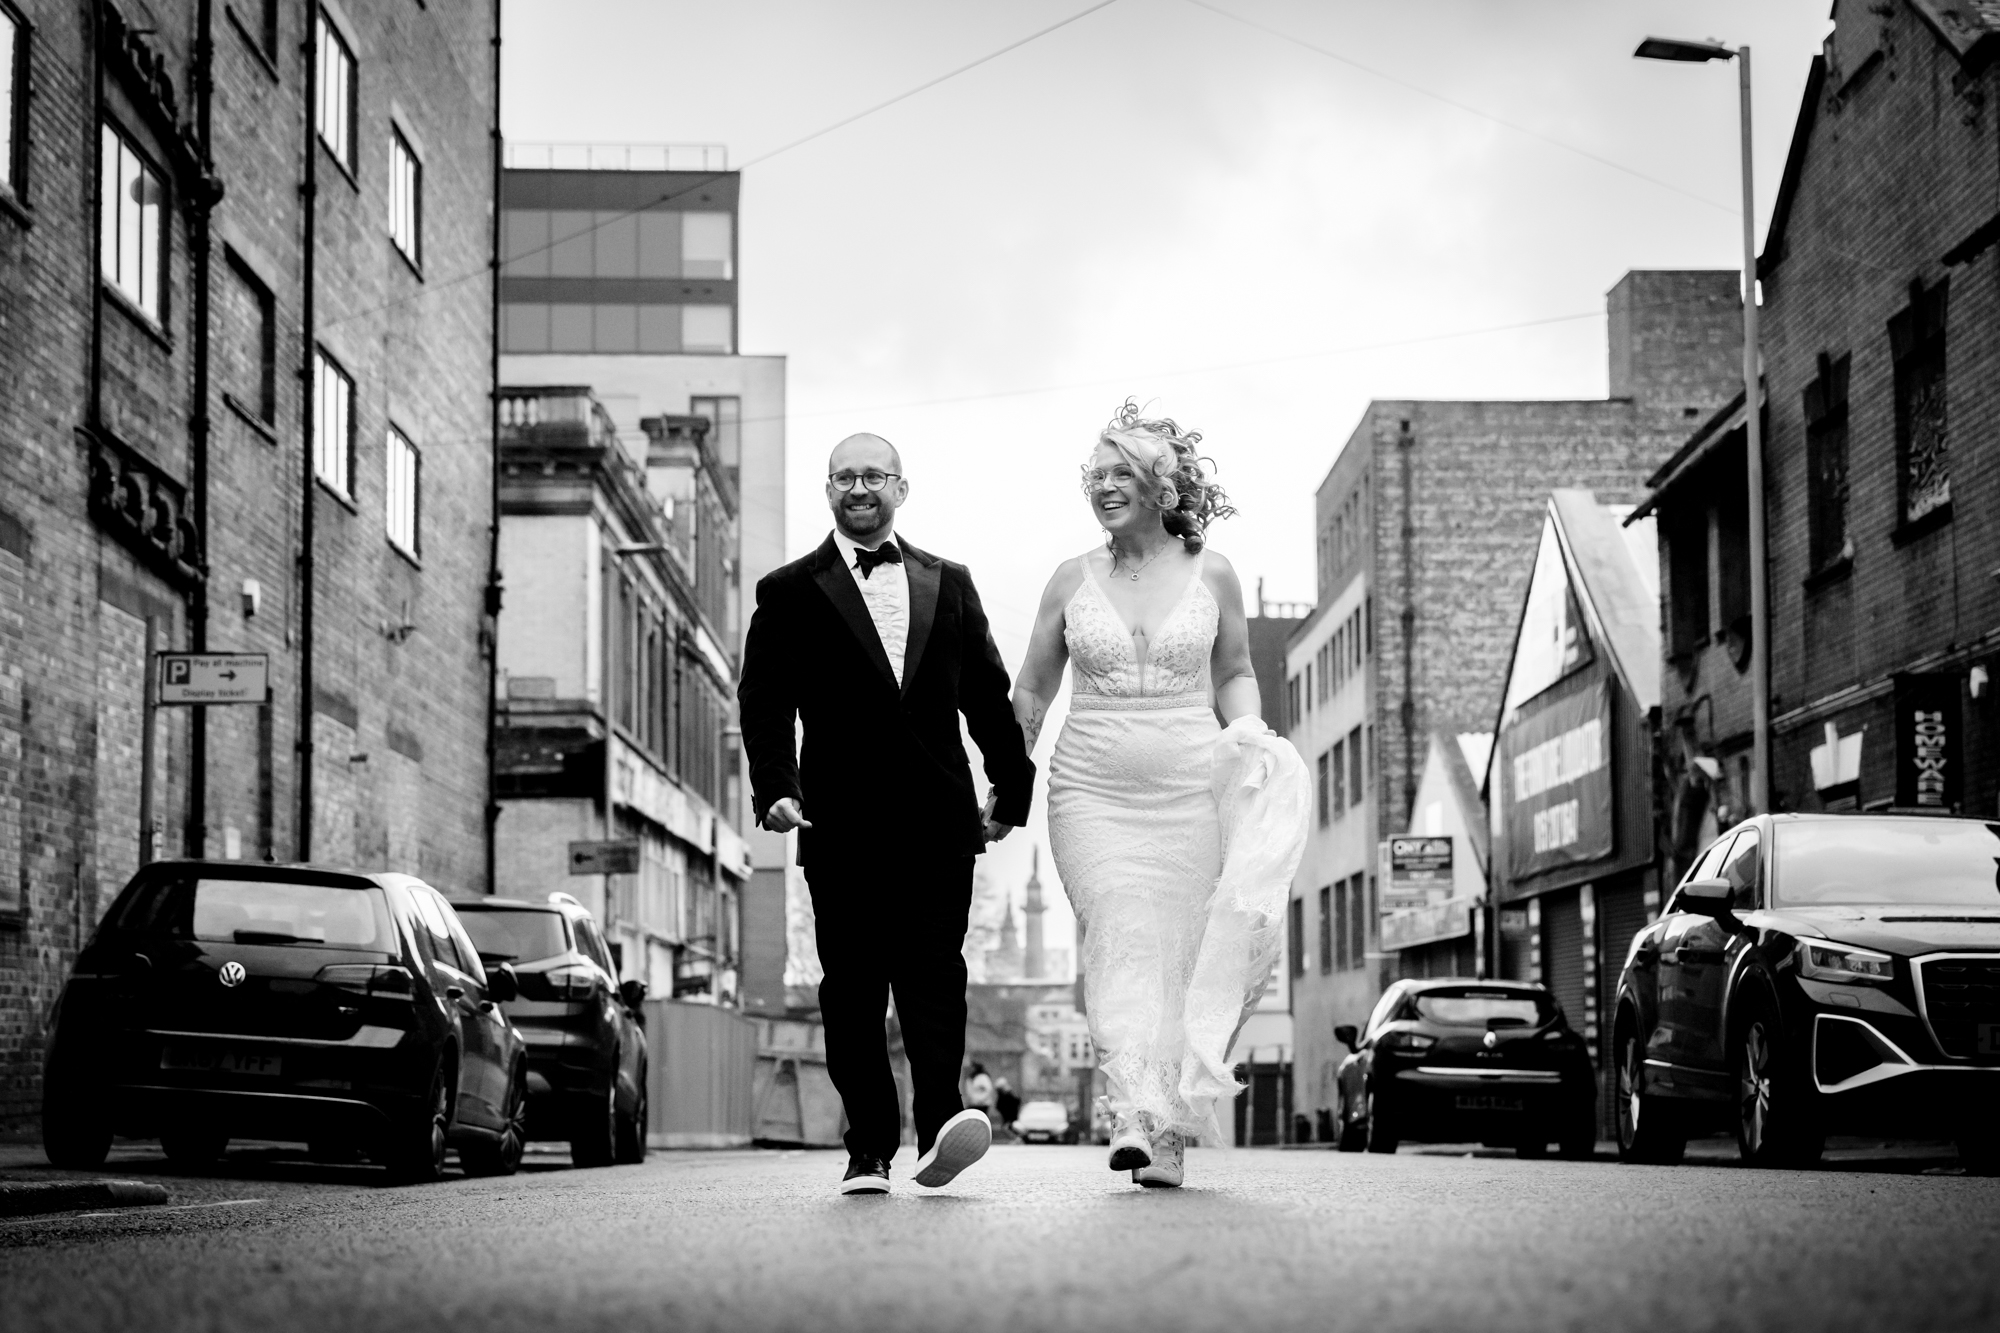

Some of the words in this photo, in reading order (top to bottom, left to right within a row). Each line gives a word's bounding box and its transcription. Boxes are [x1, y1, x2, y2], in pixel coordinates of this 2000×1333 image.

[193, 660, 209, 668] Pay
[225, 659, 263, 667] machine
[171, 661, 187, 683] P
[183, 689, 215, 698] Display
[1913, 710, 1947, 805] HOMEWARE
